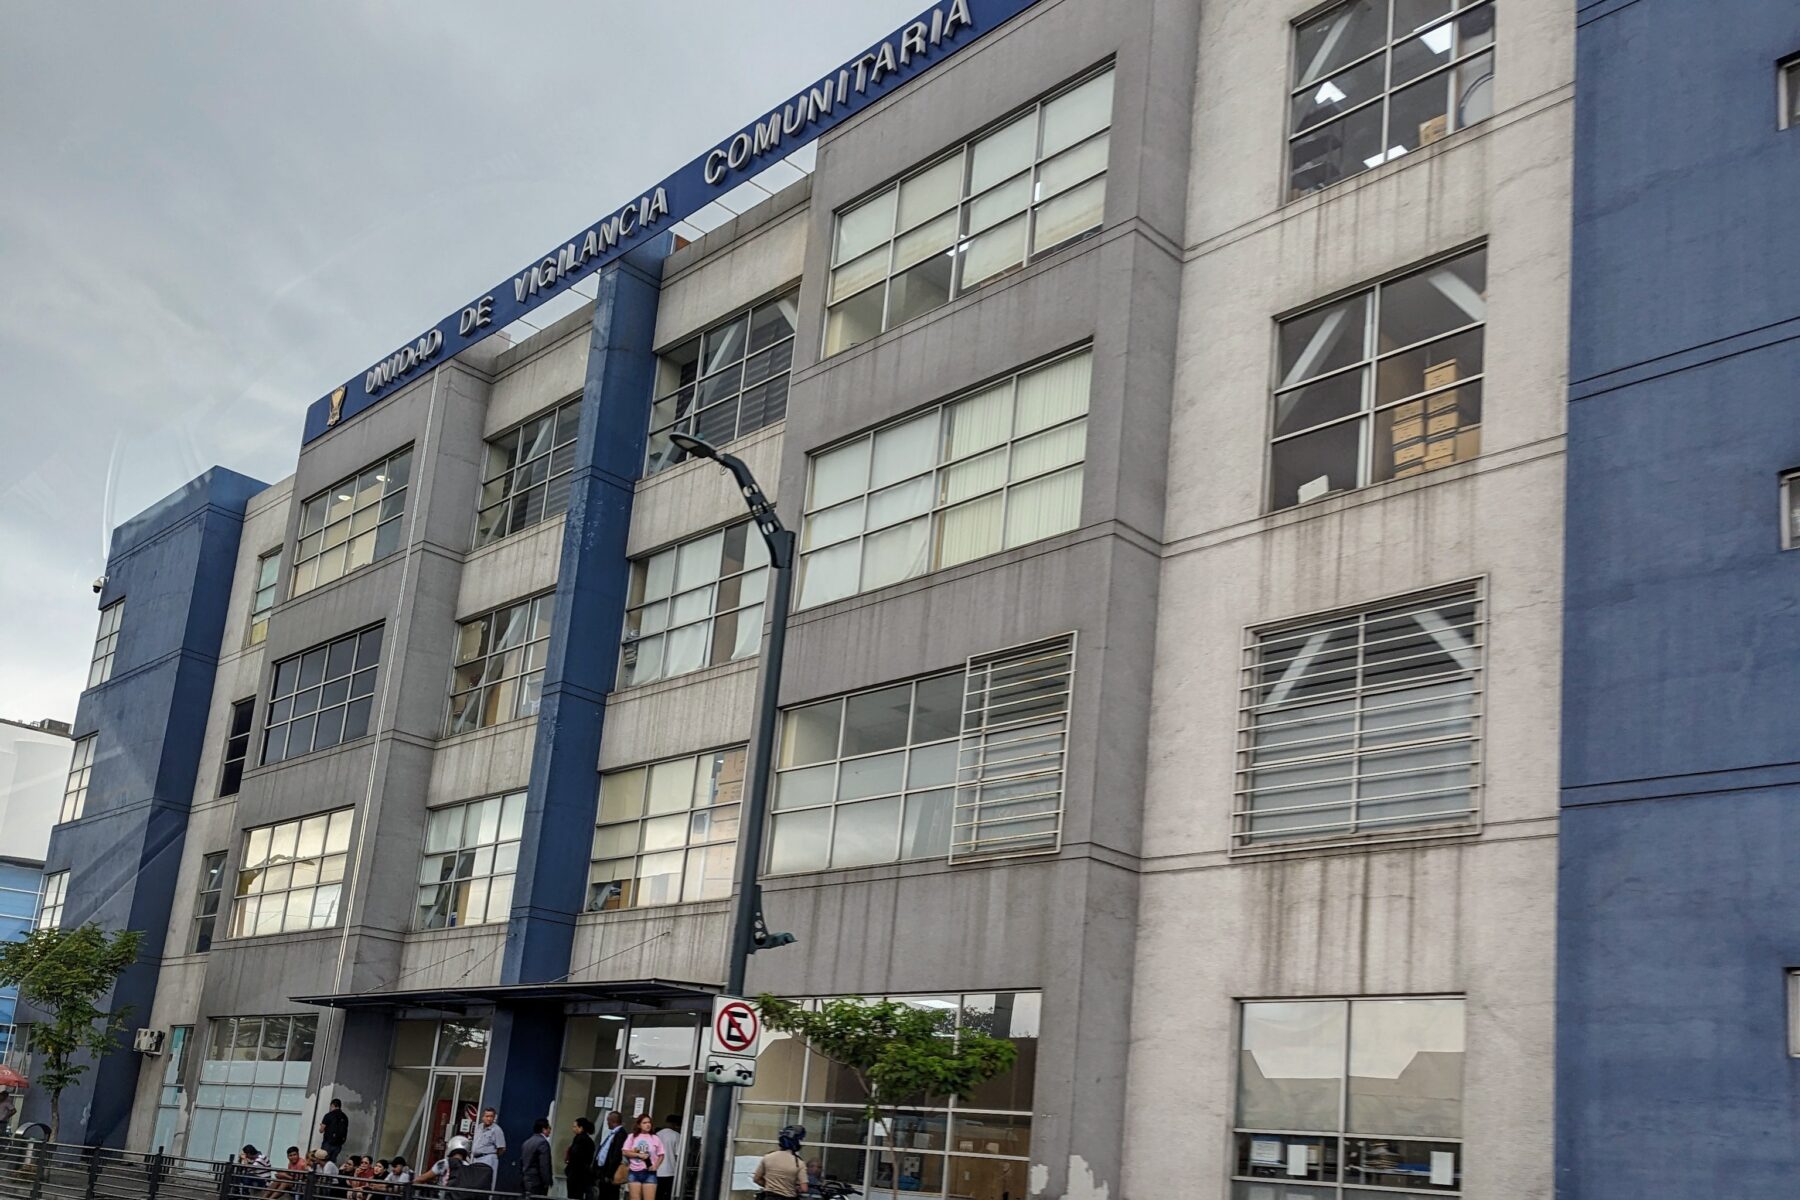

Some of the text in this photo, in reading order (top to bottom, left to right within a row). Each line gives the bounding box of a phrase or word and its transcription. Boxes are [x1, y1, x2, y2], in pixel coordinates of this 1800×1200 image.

[365, 0, 972, 394] UNIDAD DE VIGILANCIA COMUNITARIA
[727, 1010, 749, 1042] E
